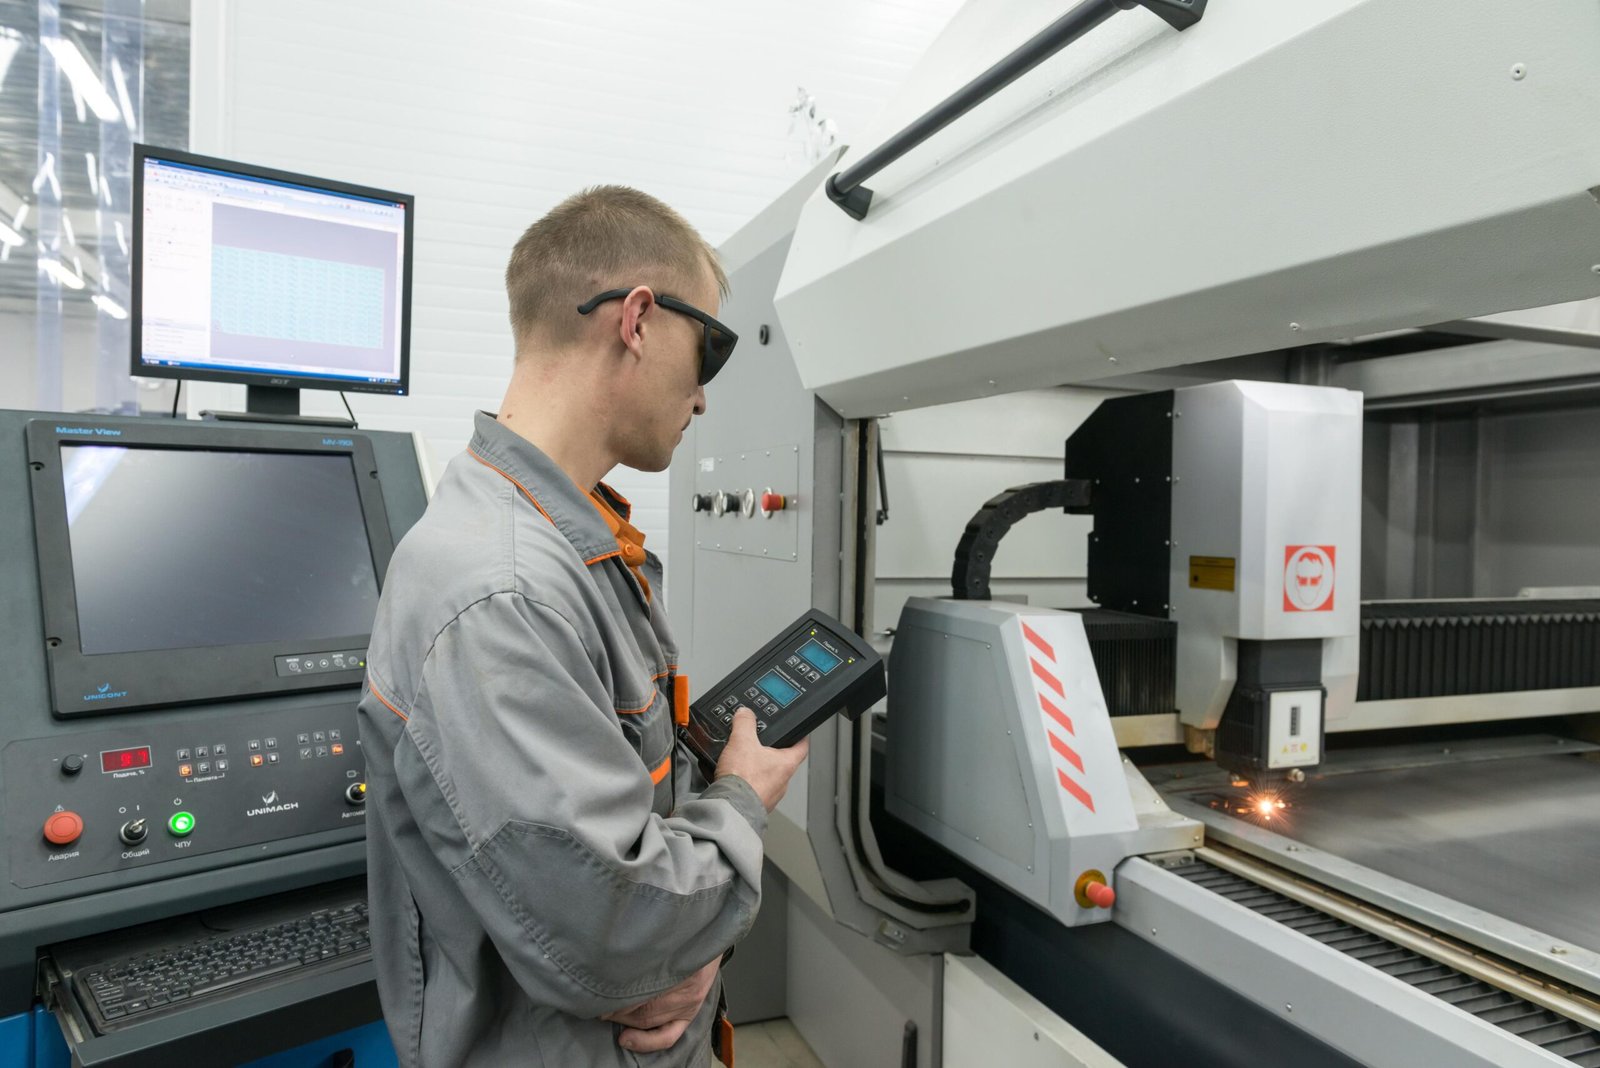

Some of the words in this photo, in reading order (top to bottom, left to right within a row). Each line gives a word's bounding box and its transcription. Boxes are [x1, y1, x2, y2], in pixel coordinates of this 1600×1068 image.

[55, 426, 93, 435] Master
[95, 428, 121, 436] View
[247, 802, 299, 817] UNIMACH
[174, 840, 192, 849] ЧПУ
[48, 851, 80, 862] Авария
[121, 848, 150, 860] Общий
